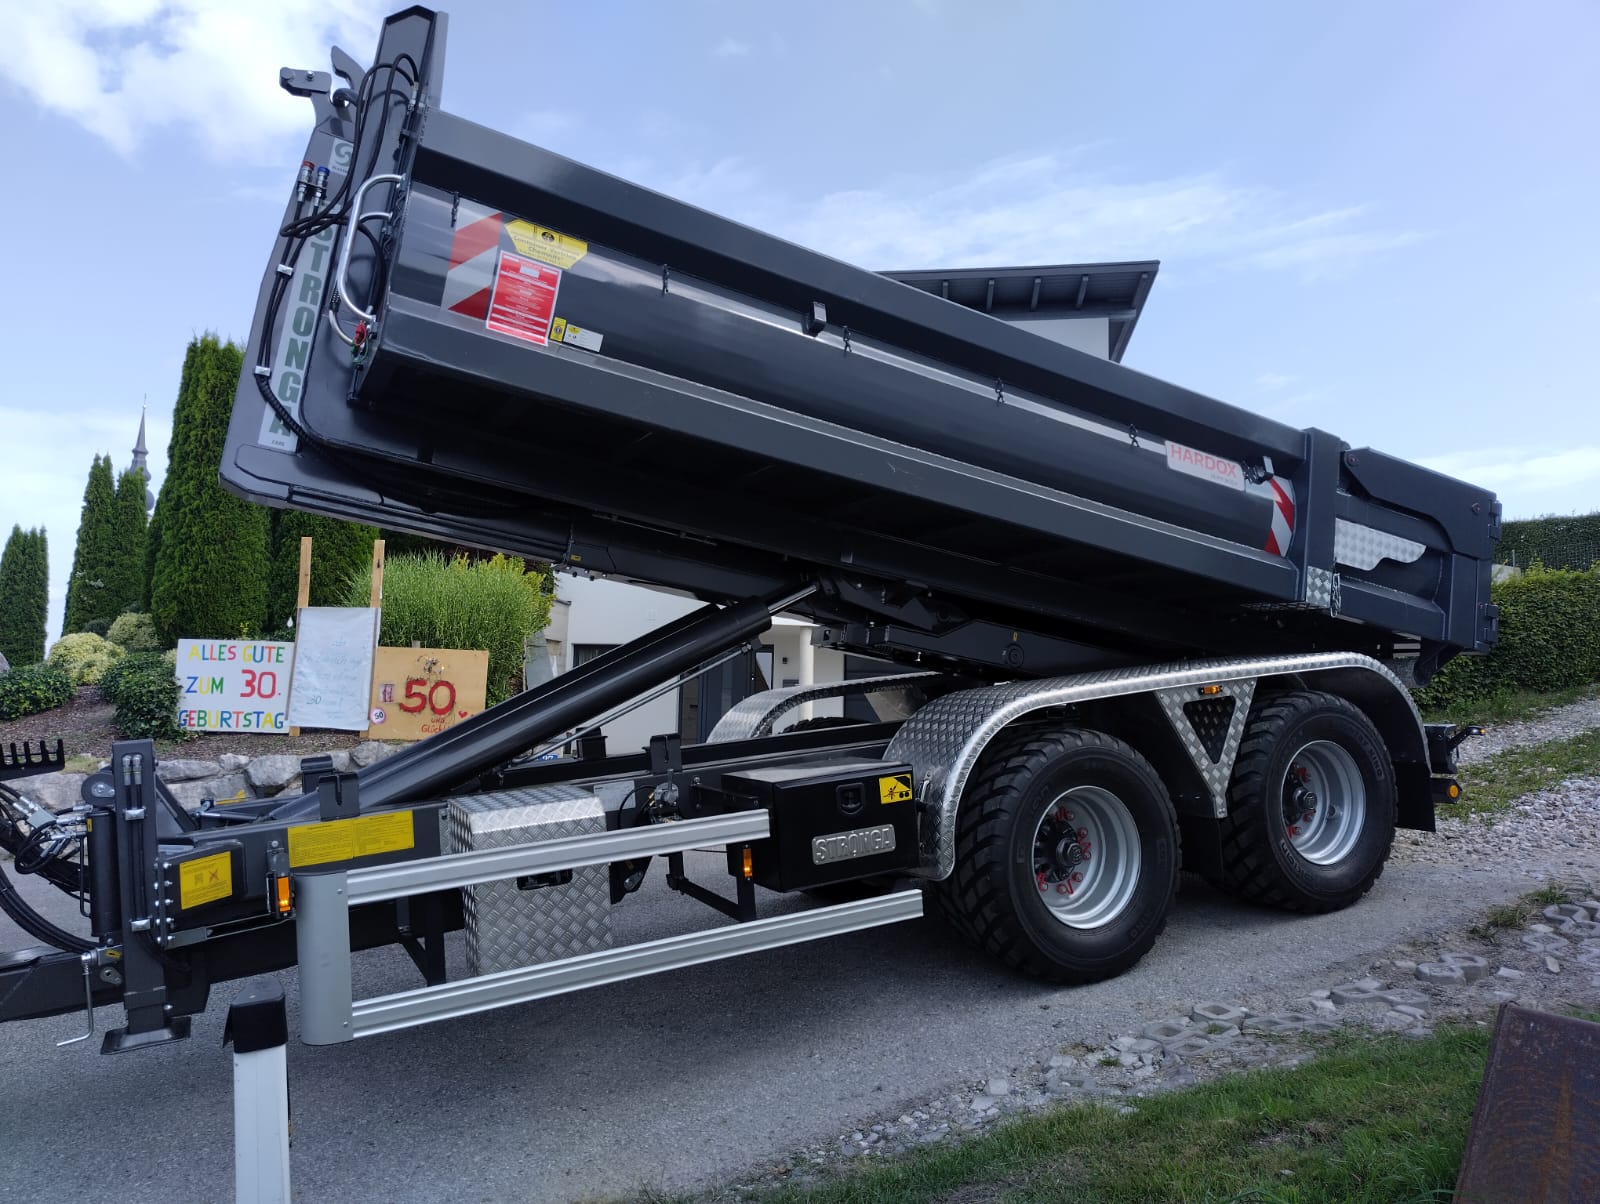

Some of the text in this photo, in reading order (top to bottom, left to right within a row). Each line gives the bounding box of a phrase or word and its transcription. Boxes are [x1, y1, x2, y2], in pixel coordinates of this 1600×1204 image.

[1170, 443, 1236, 477] HARDOX
[188, 644, 285, 663] ALLES GUTE
[185, 675, 224, 695] ZUM
[398, 679, 456, 716] 50
[178, 709, 285, 730] GEBURTSTAG
[816, 828, 892, 859] STRONGA
